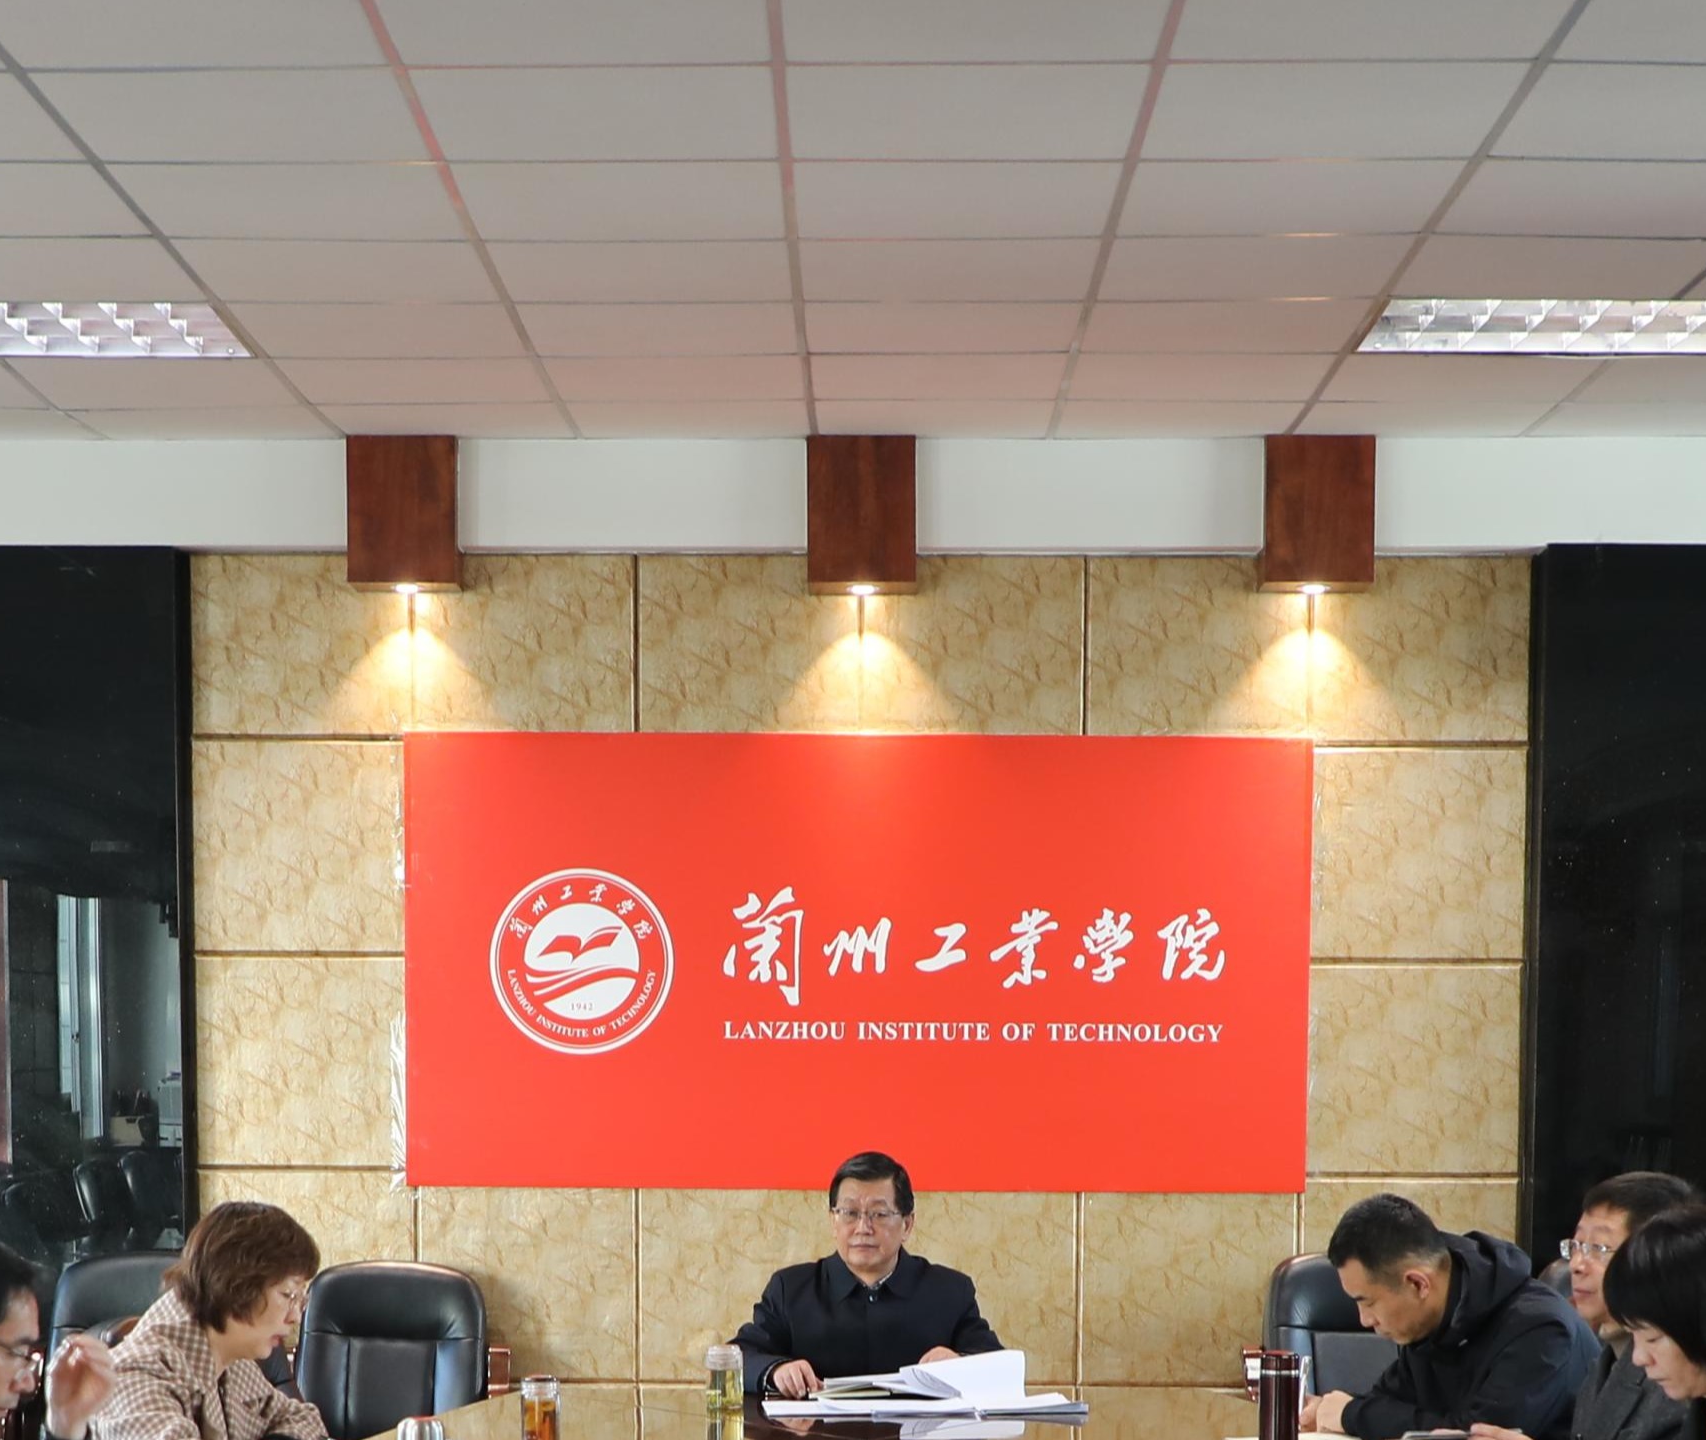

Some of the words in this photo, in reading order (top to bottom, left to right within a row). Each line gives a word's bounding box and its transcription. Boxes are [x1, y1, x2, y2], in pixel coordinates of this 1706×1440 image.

[507, 969, 537, 1016] LANZHOU
[536, 1015, 589, 1038] INSTITUTE
[592, 1024, 607, 1037] OF
[609, 969, 657, 1031] TECHNOLOGY
[570, 1002, 594, 1012] 1942
[724, 1020, 846, 1041] LANZHOU
[858, 1021, 990, 1042] INSTITUTE
[1002, 1022, 1036, 1042] OF
[1046, 1023, 1223, 1043] TECHNOLOGY
